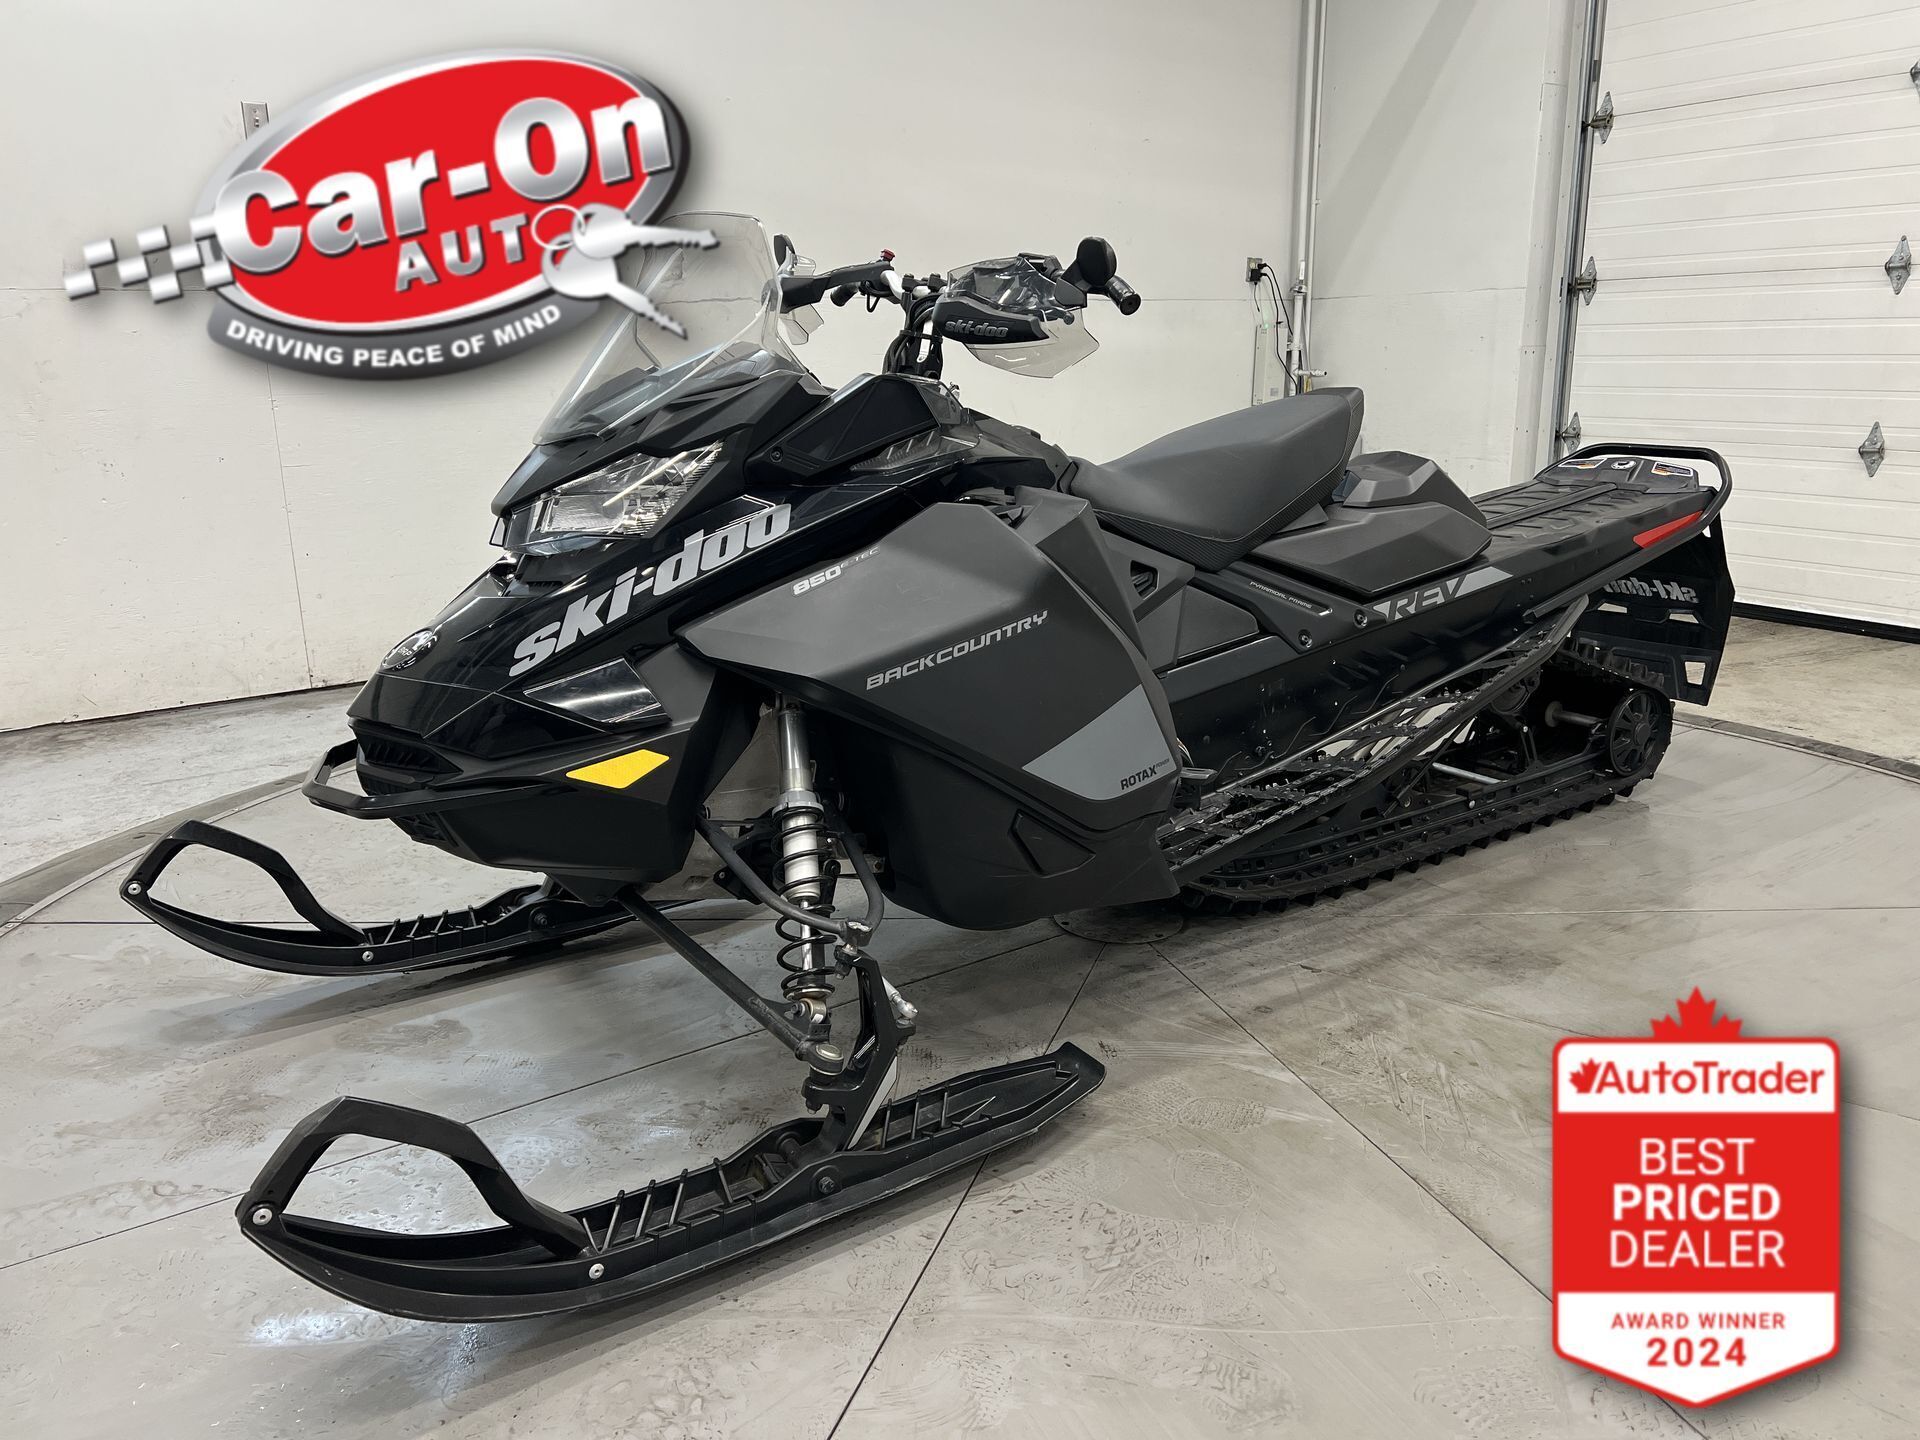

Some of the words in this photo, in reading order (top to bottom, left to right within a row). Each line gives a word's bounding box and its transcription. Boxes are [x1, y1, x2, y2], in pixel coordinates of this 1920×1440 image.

[945, 319, 1009, 338] ski-doo
[793, 565, 842, 595] 850
[1385, 573, 1468, 623] REV
[866, 610, 1048, 690] BACKCOUNTRY
[1120, 764, 1157, 790] ROTAX
